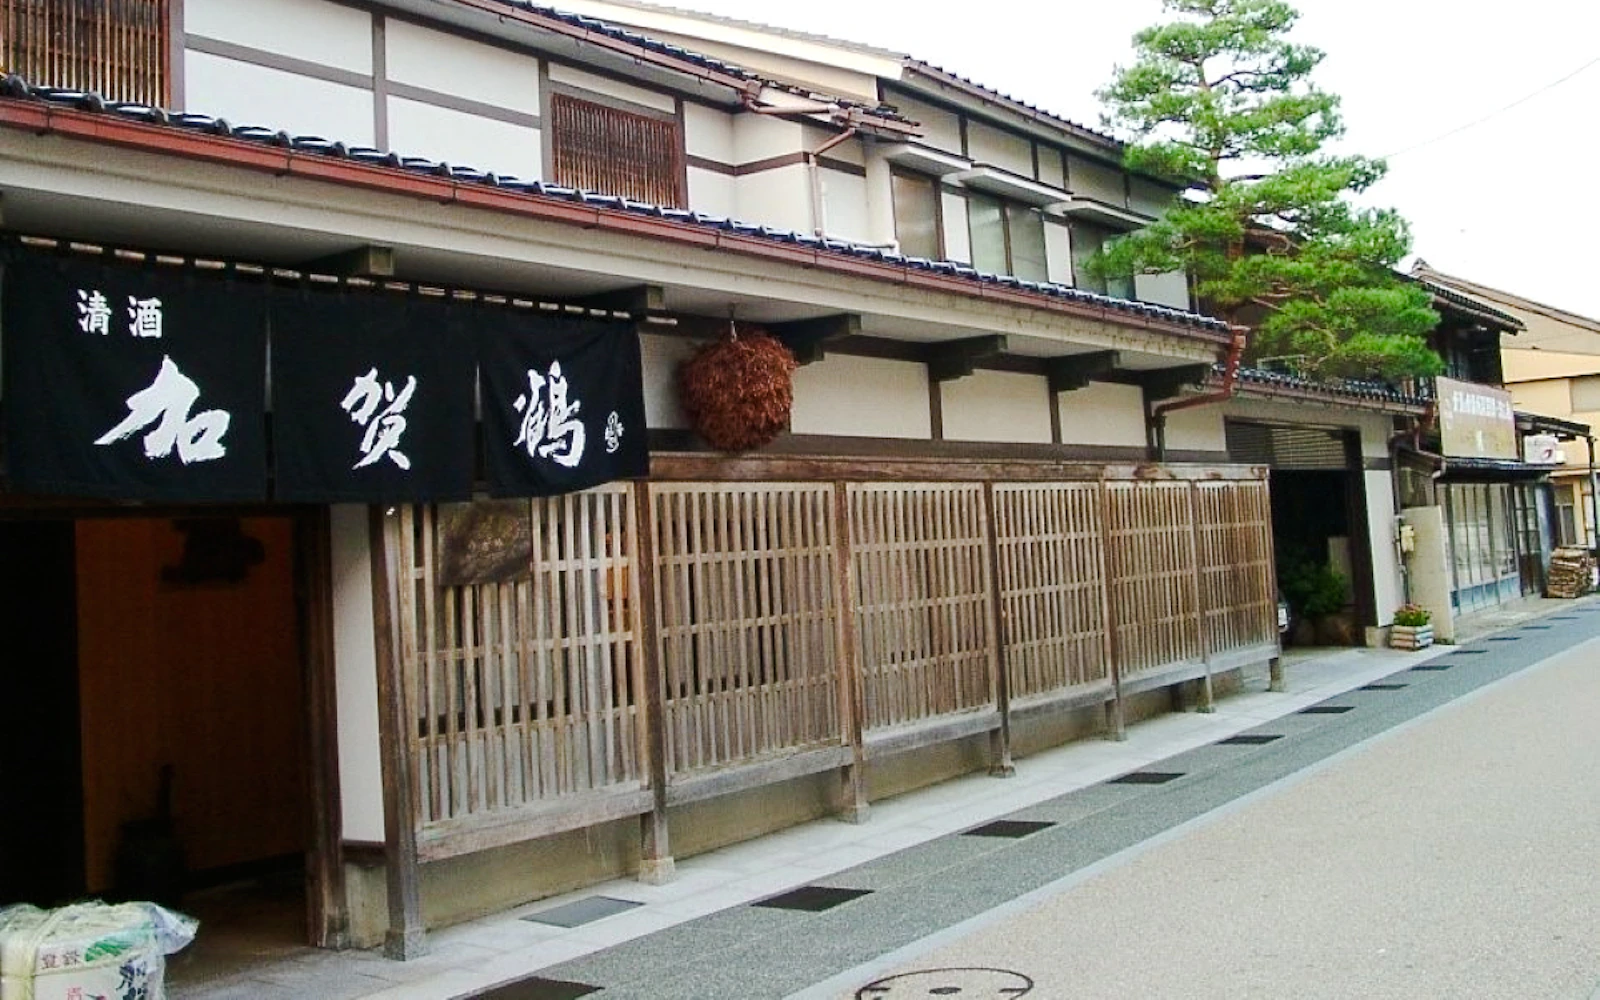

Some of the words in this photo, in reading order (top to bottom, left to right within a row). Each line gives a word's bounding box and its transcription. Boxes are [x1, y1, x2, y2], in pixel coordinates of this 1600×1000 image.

[77, 289, 163, 339] 清酒
[93, 354, 588, 471] 加賀鶴
